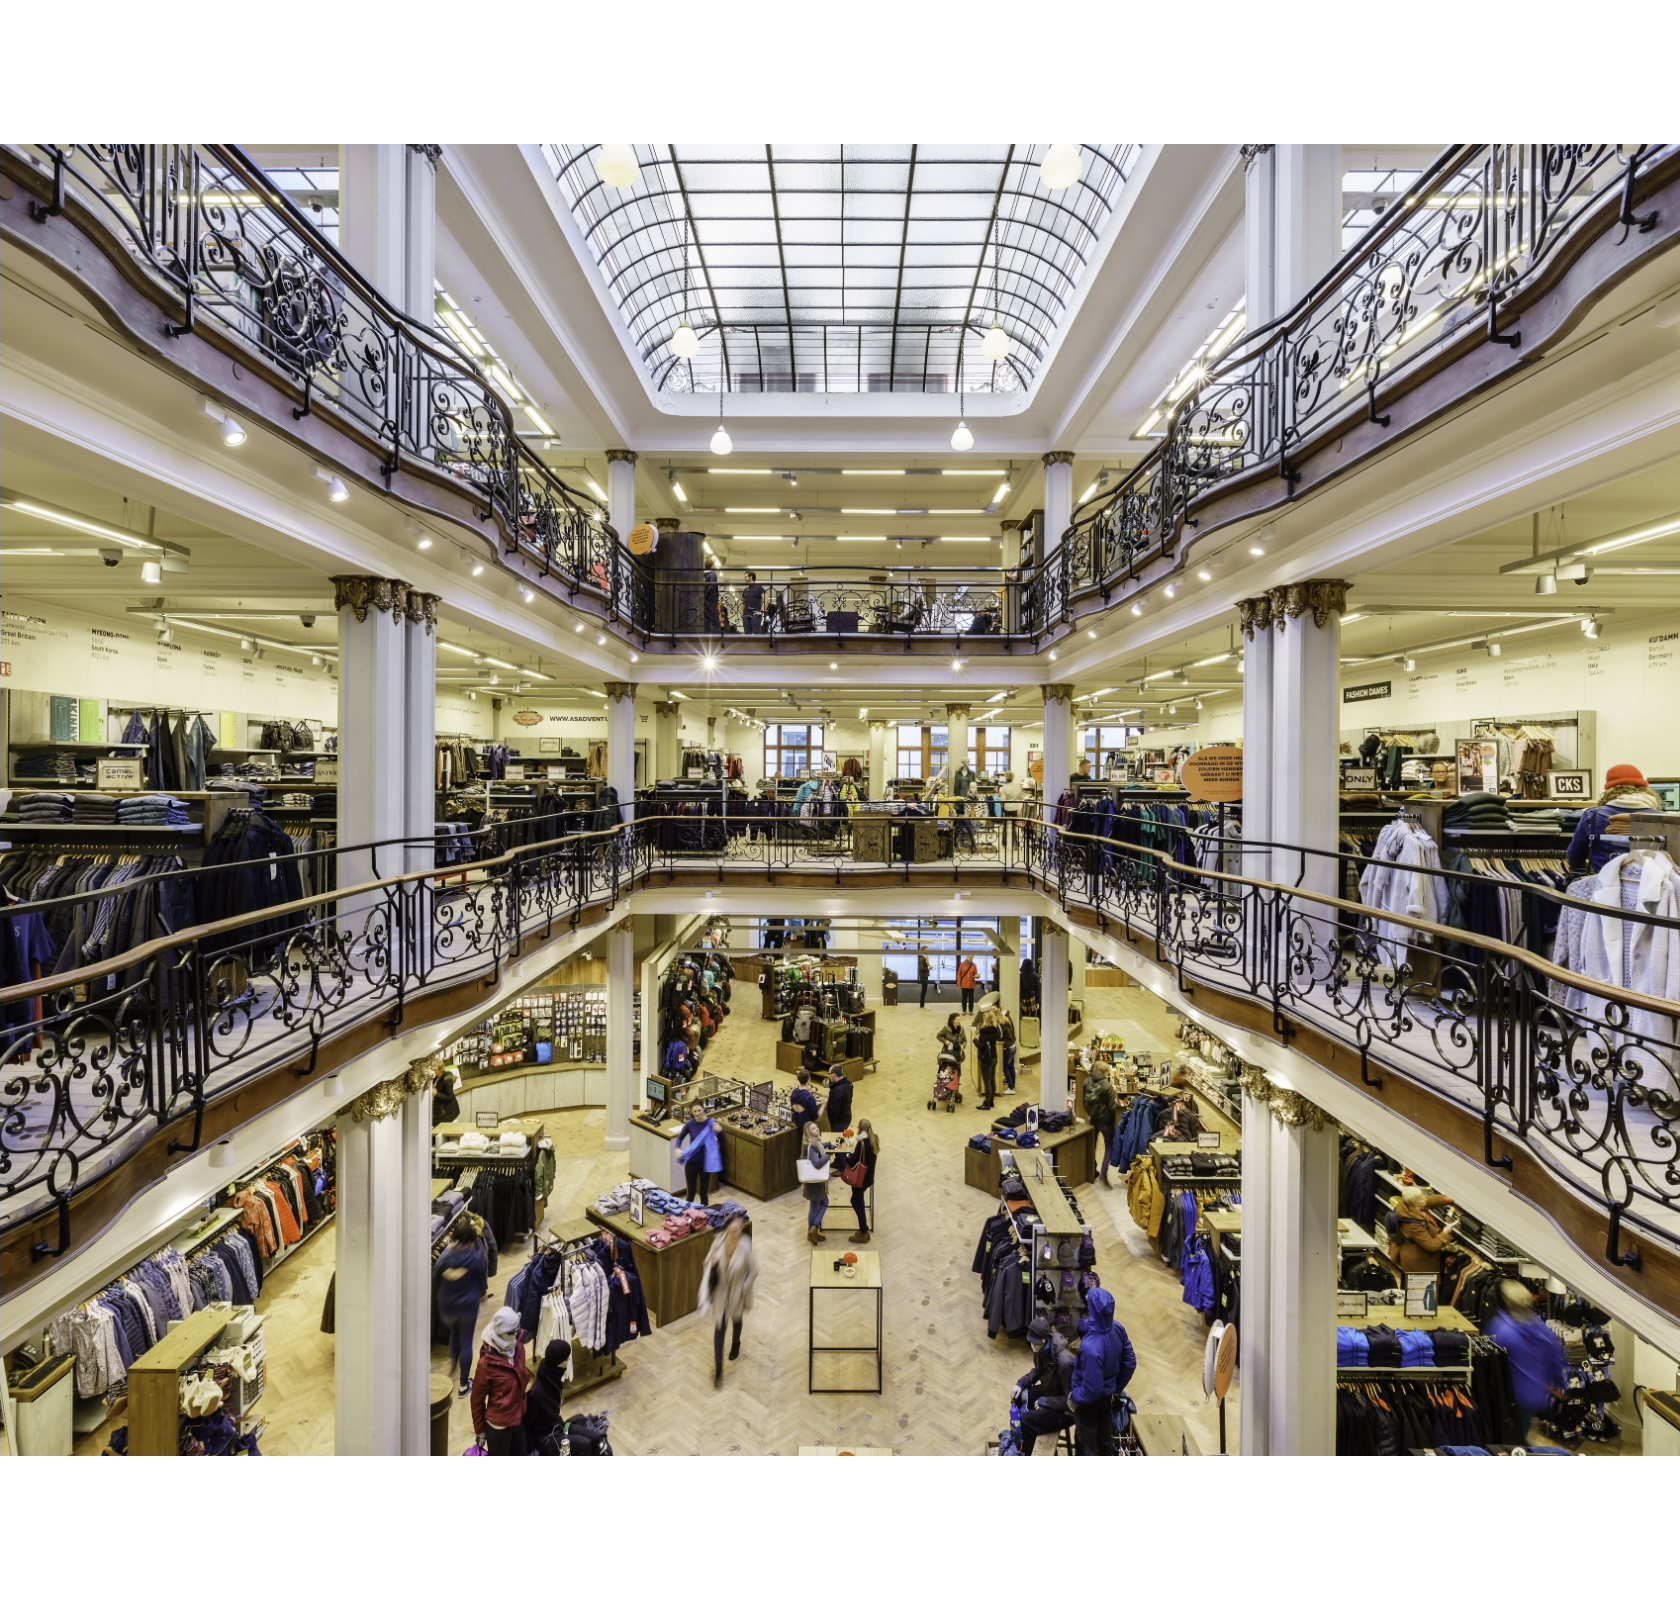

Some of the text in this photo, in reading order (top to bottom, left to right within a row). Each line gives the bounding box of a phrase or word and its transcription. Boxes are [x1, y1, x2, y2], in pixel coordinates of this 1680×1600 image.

[1, 629, 37, 641] Great Britain
[1648, 652, 1673, 661] Germany
[1346, 685, 1388, 700] FASHION DAMES
[1346, 775, 1374, 783] ONLY
[1557, 777, 1582, 792] CKS
